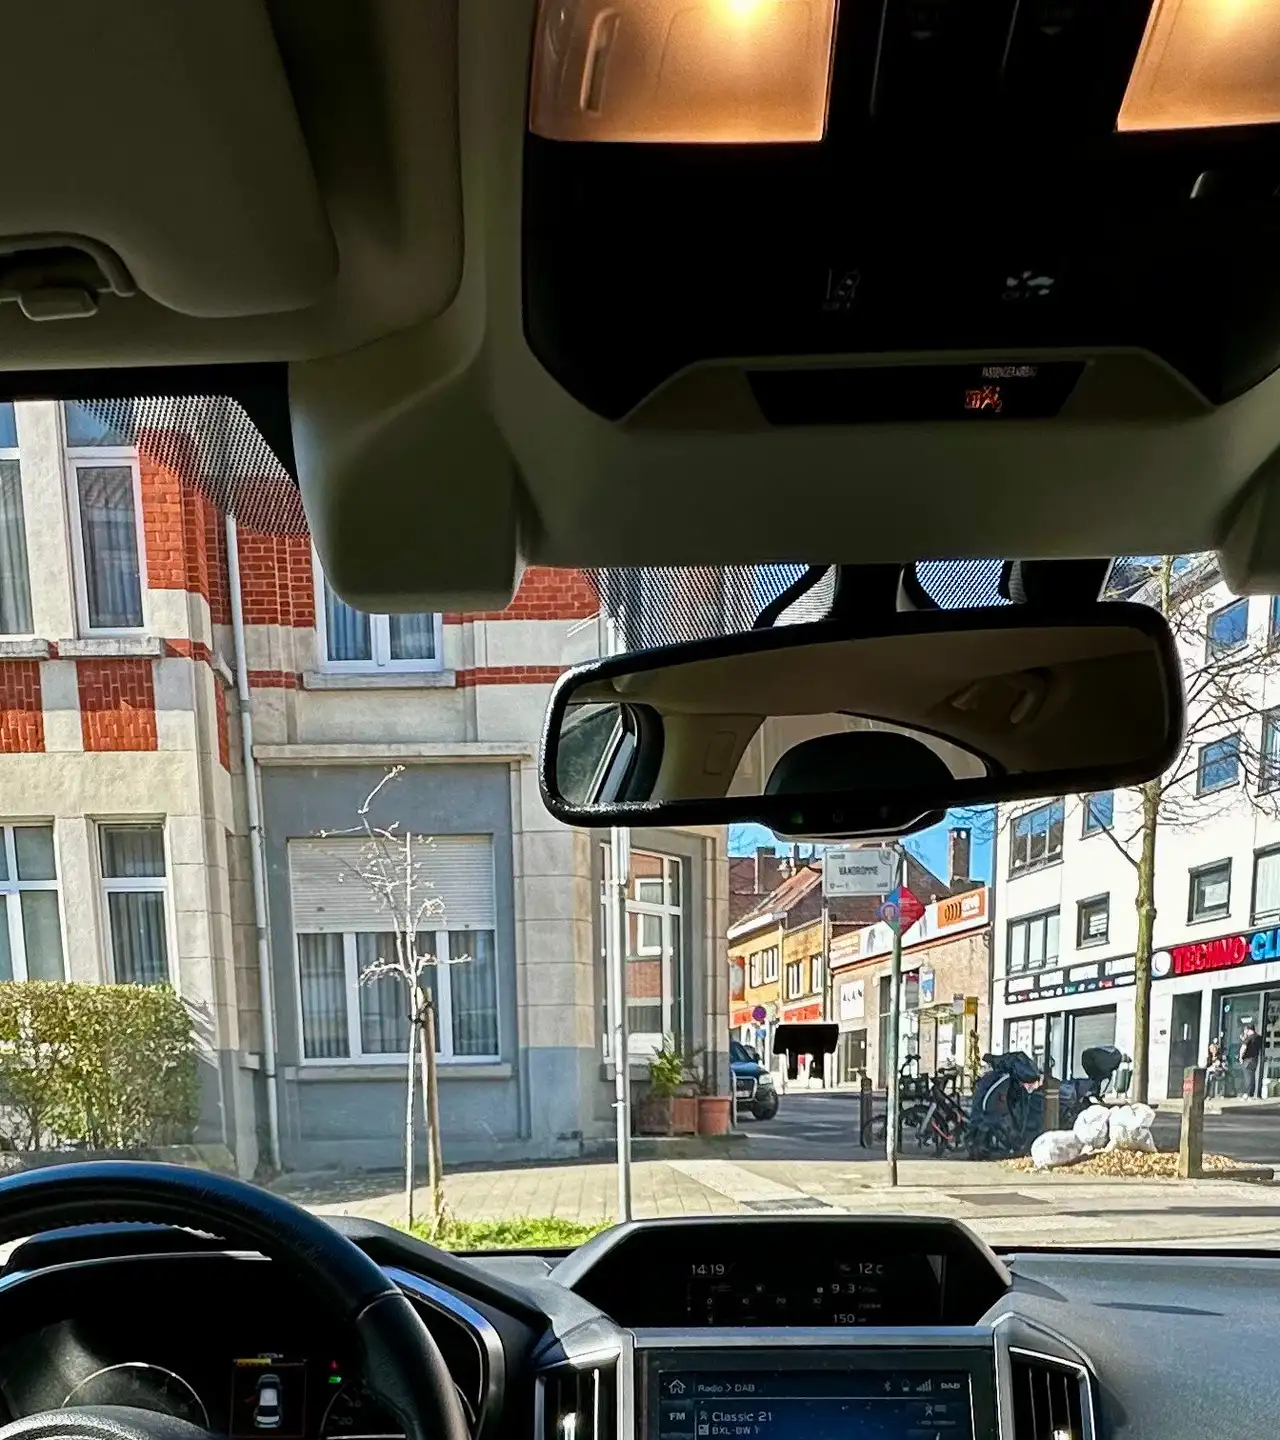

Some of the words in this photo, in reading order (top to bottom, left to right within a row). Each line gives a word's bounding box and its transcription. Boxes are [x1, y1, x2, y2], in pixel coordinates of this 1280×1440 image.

[692, 1264, 725, 1276] 14:19
[832, 1314, 856, 1324] 150
[697, 1384, 723, 1392] Radio
[734, 1384, 755, 1392] DAB
[669, 1412, 686, 1421] FM
[712, 1412, 754, 1422] Classic
[758, 1411, 773, 1422] 21
